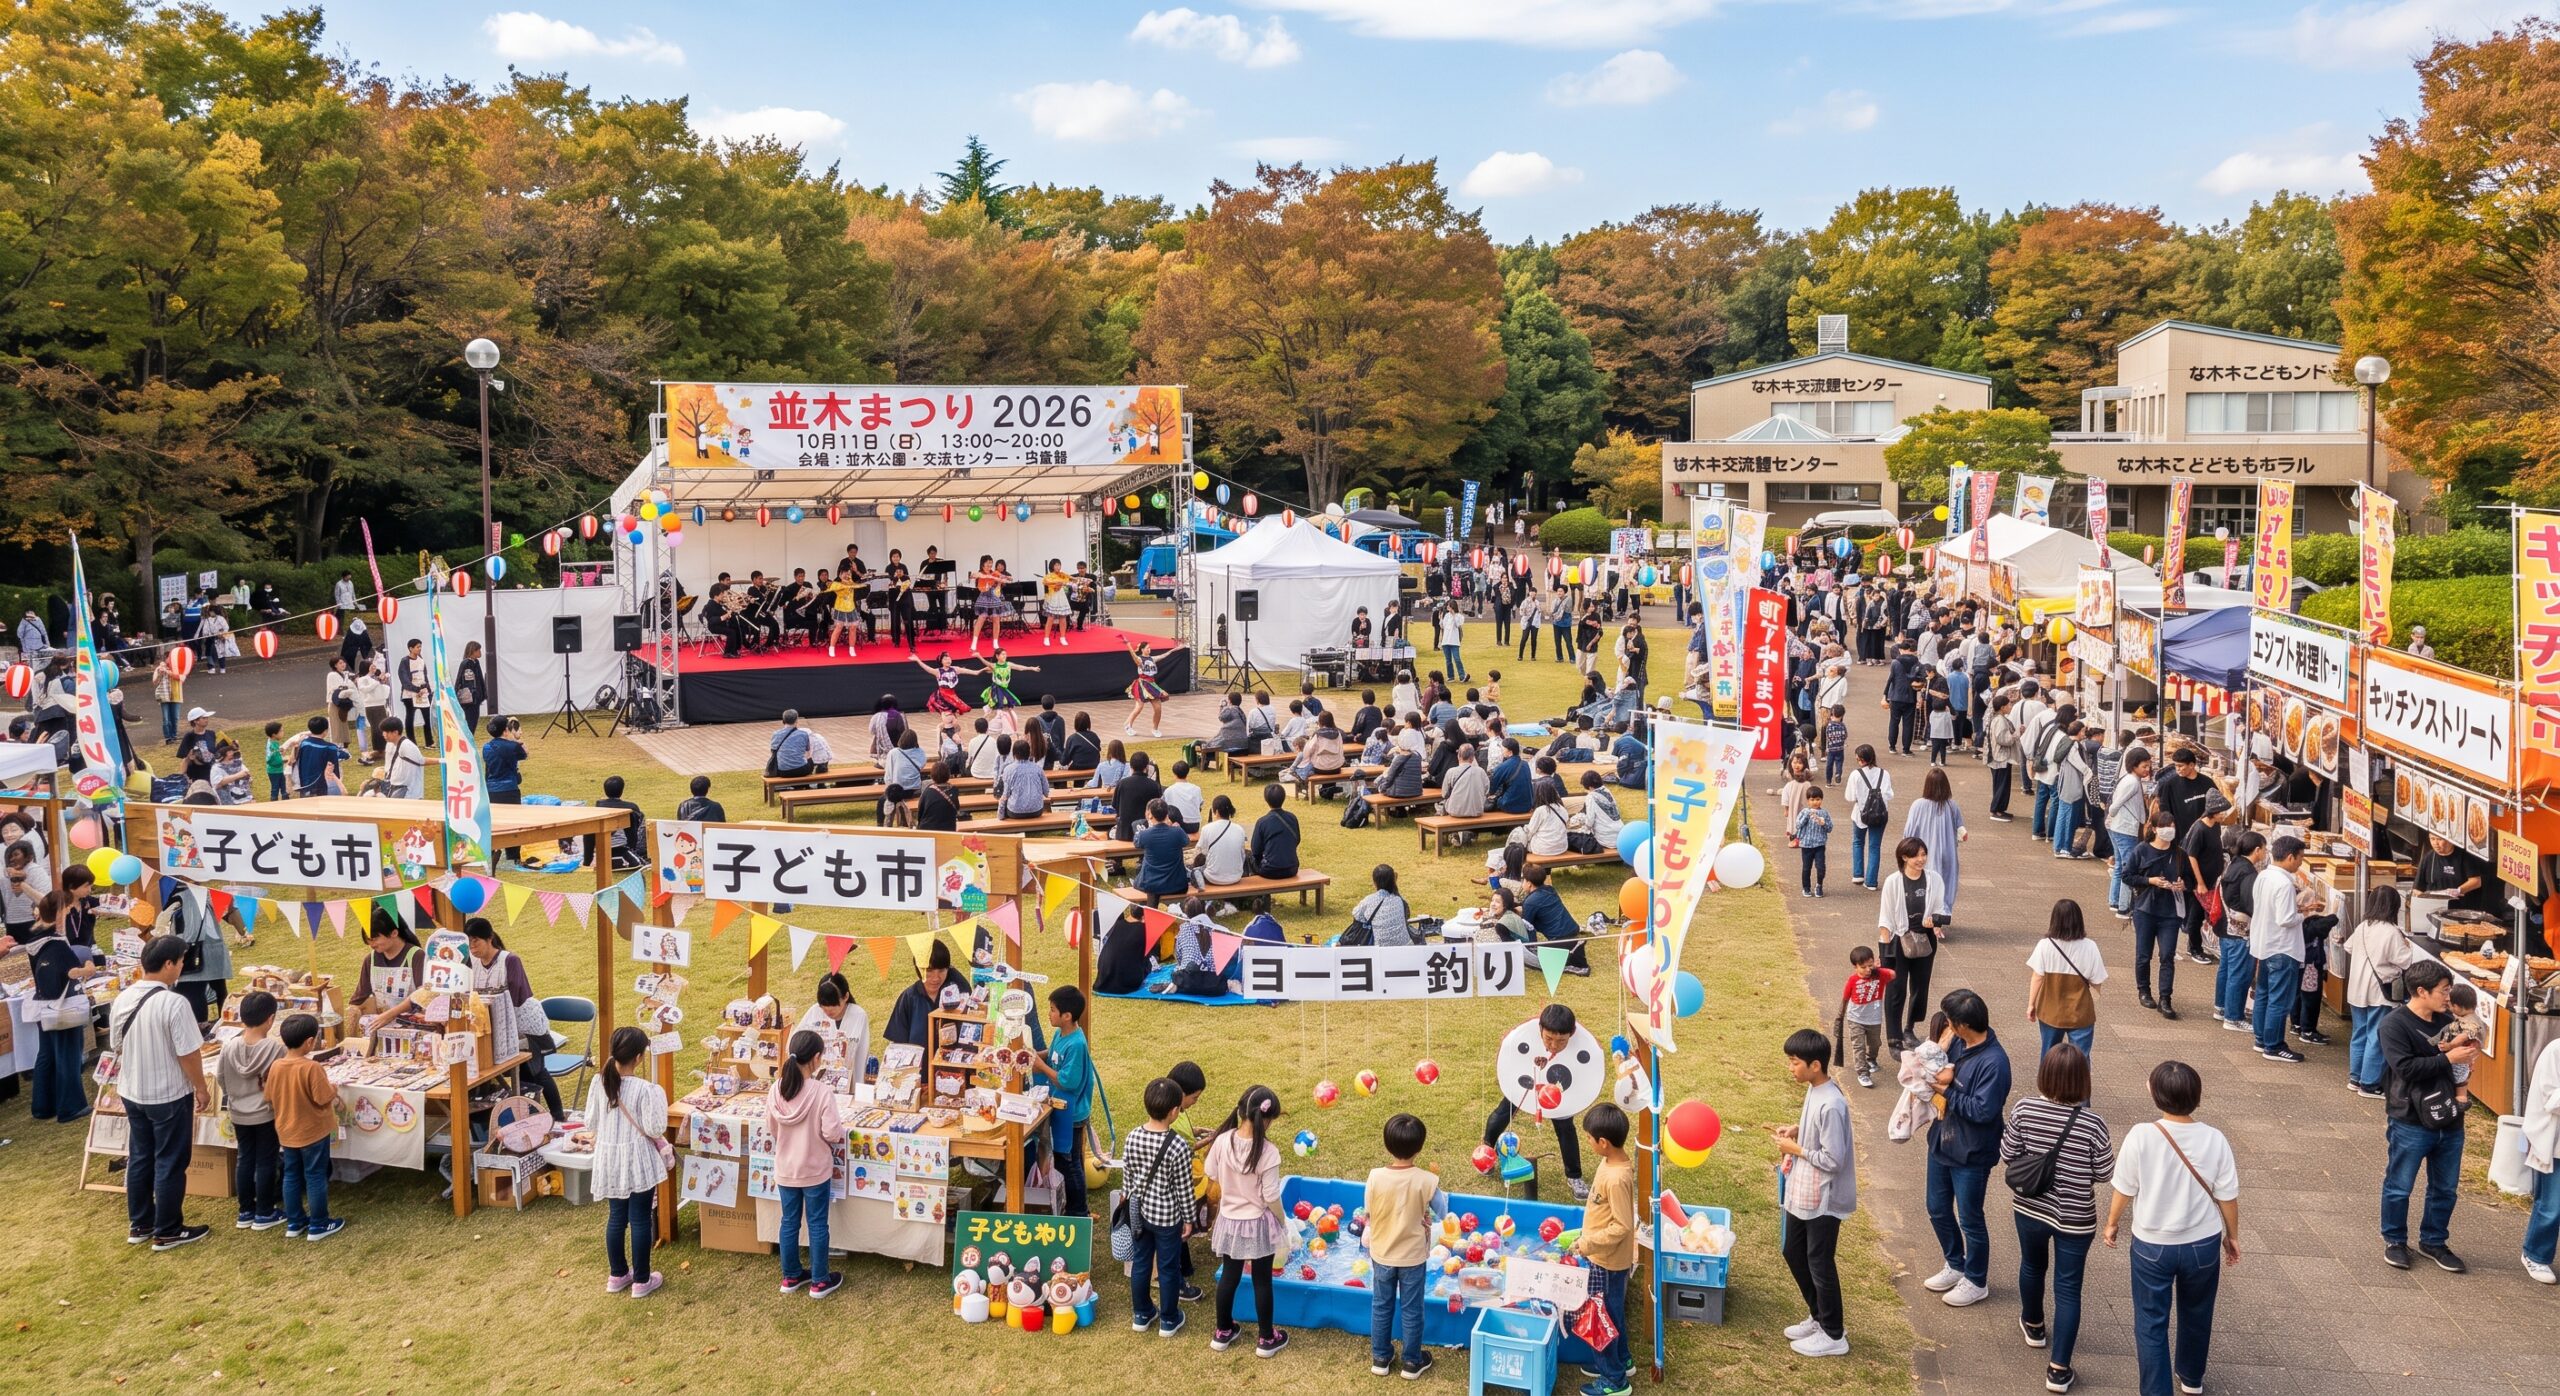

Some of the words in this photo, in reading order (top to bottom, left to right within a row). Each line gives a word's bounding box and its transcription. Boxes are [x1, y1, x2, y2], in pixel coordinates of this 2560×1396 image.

[768, 390, 974, 431] 並木まつり
[993, 394, 1092, 428] 2026
[2369, 678, 2502, 761] キッチンストリート
[203, 828, 373, 882] 子ども市
[713, 843, 926, 902] 子ども市
[1252, 950, 1513, 994] ヨーヨー釣り
